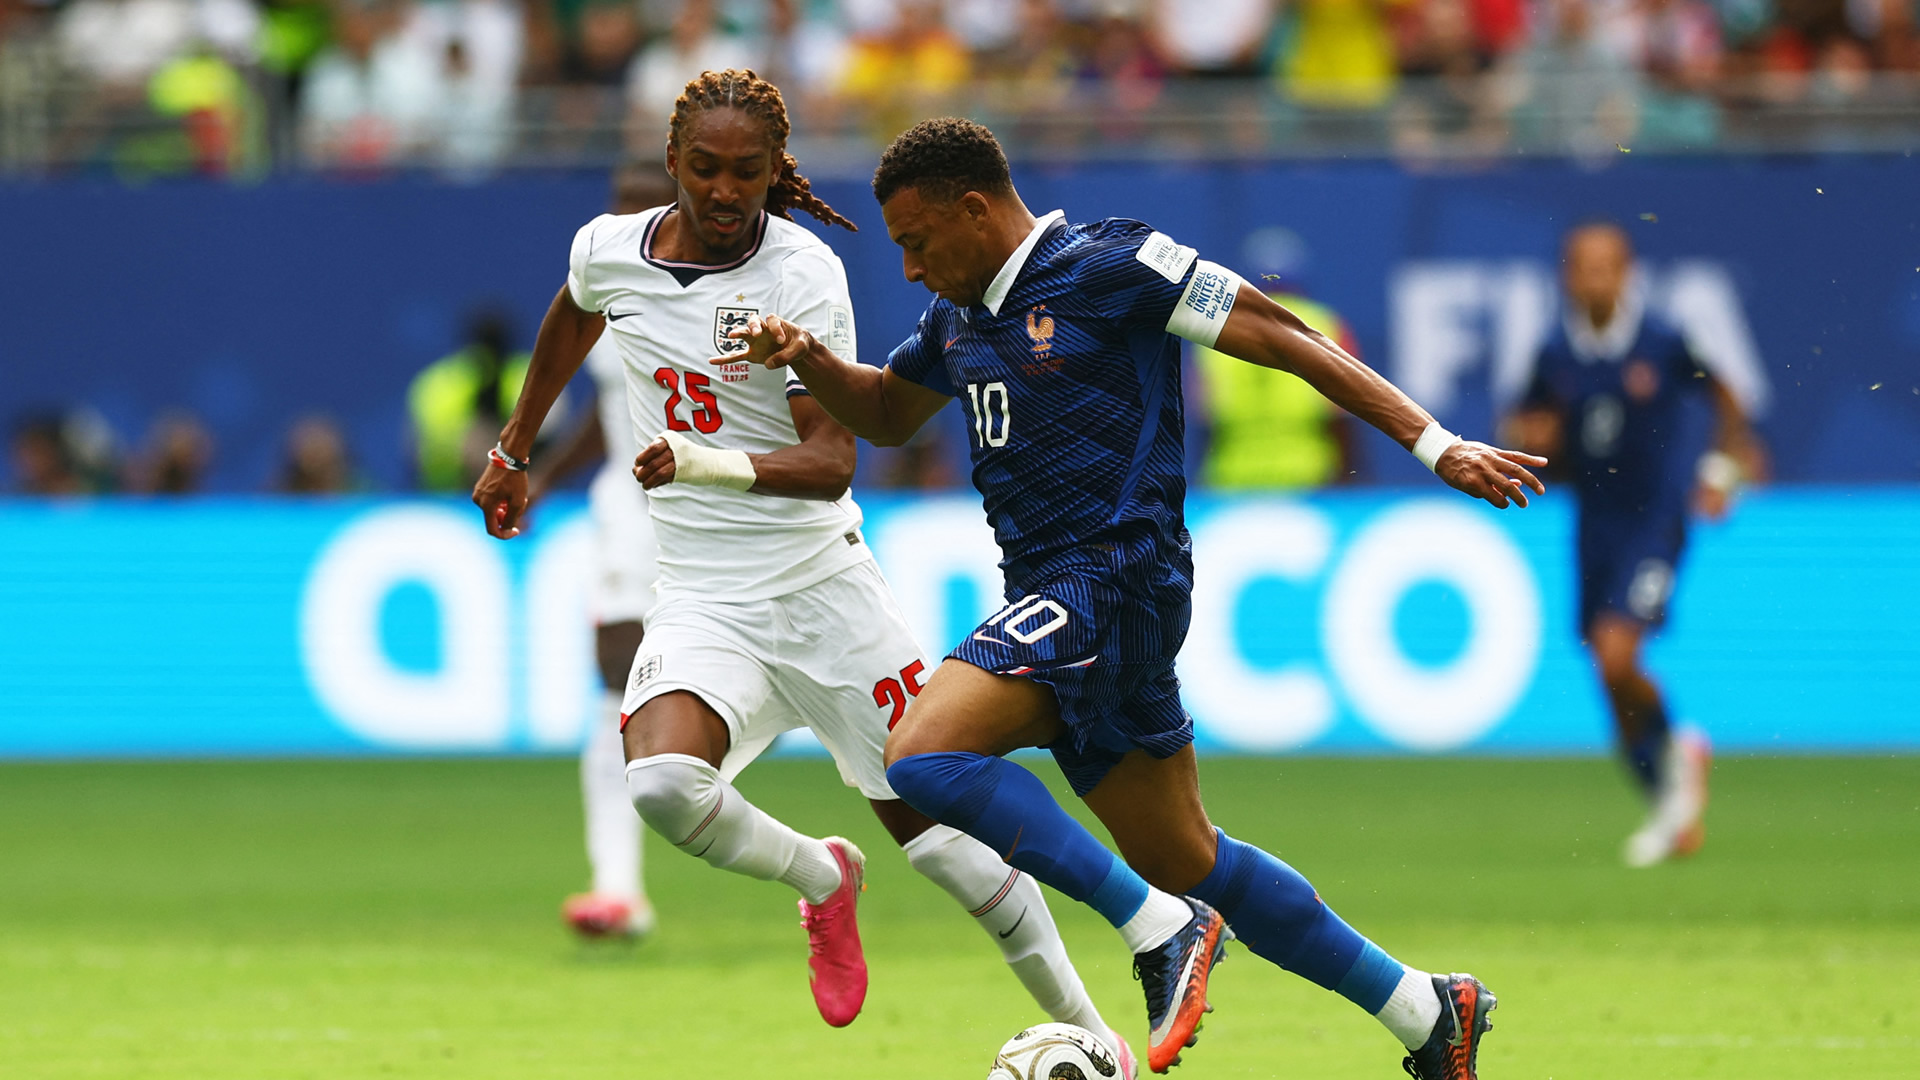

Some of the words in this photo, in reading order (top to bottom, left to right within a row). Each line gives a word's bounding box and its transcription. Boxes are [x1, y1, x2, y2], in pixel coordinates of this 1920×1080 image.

[1185, 271, 1207, 308] FOOTBALL
[1193, 272, 1218, 314] UNITES
[1205, 303, 1219, 320] the
[1212, 275, 1230, 304] World
[1221, 293, 1234, 312] FIFA
[1390, 260, 1768, 416] FIA
[719, 364, 749, 373] FRANCE
[653, 367, 723, 434] 25
[967, 382, 1010, 448] 10
[304, 504, 1541, 750] arco
[986, 594, 1068, 644] 10
